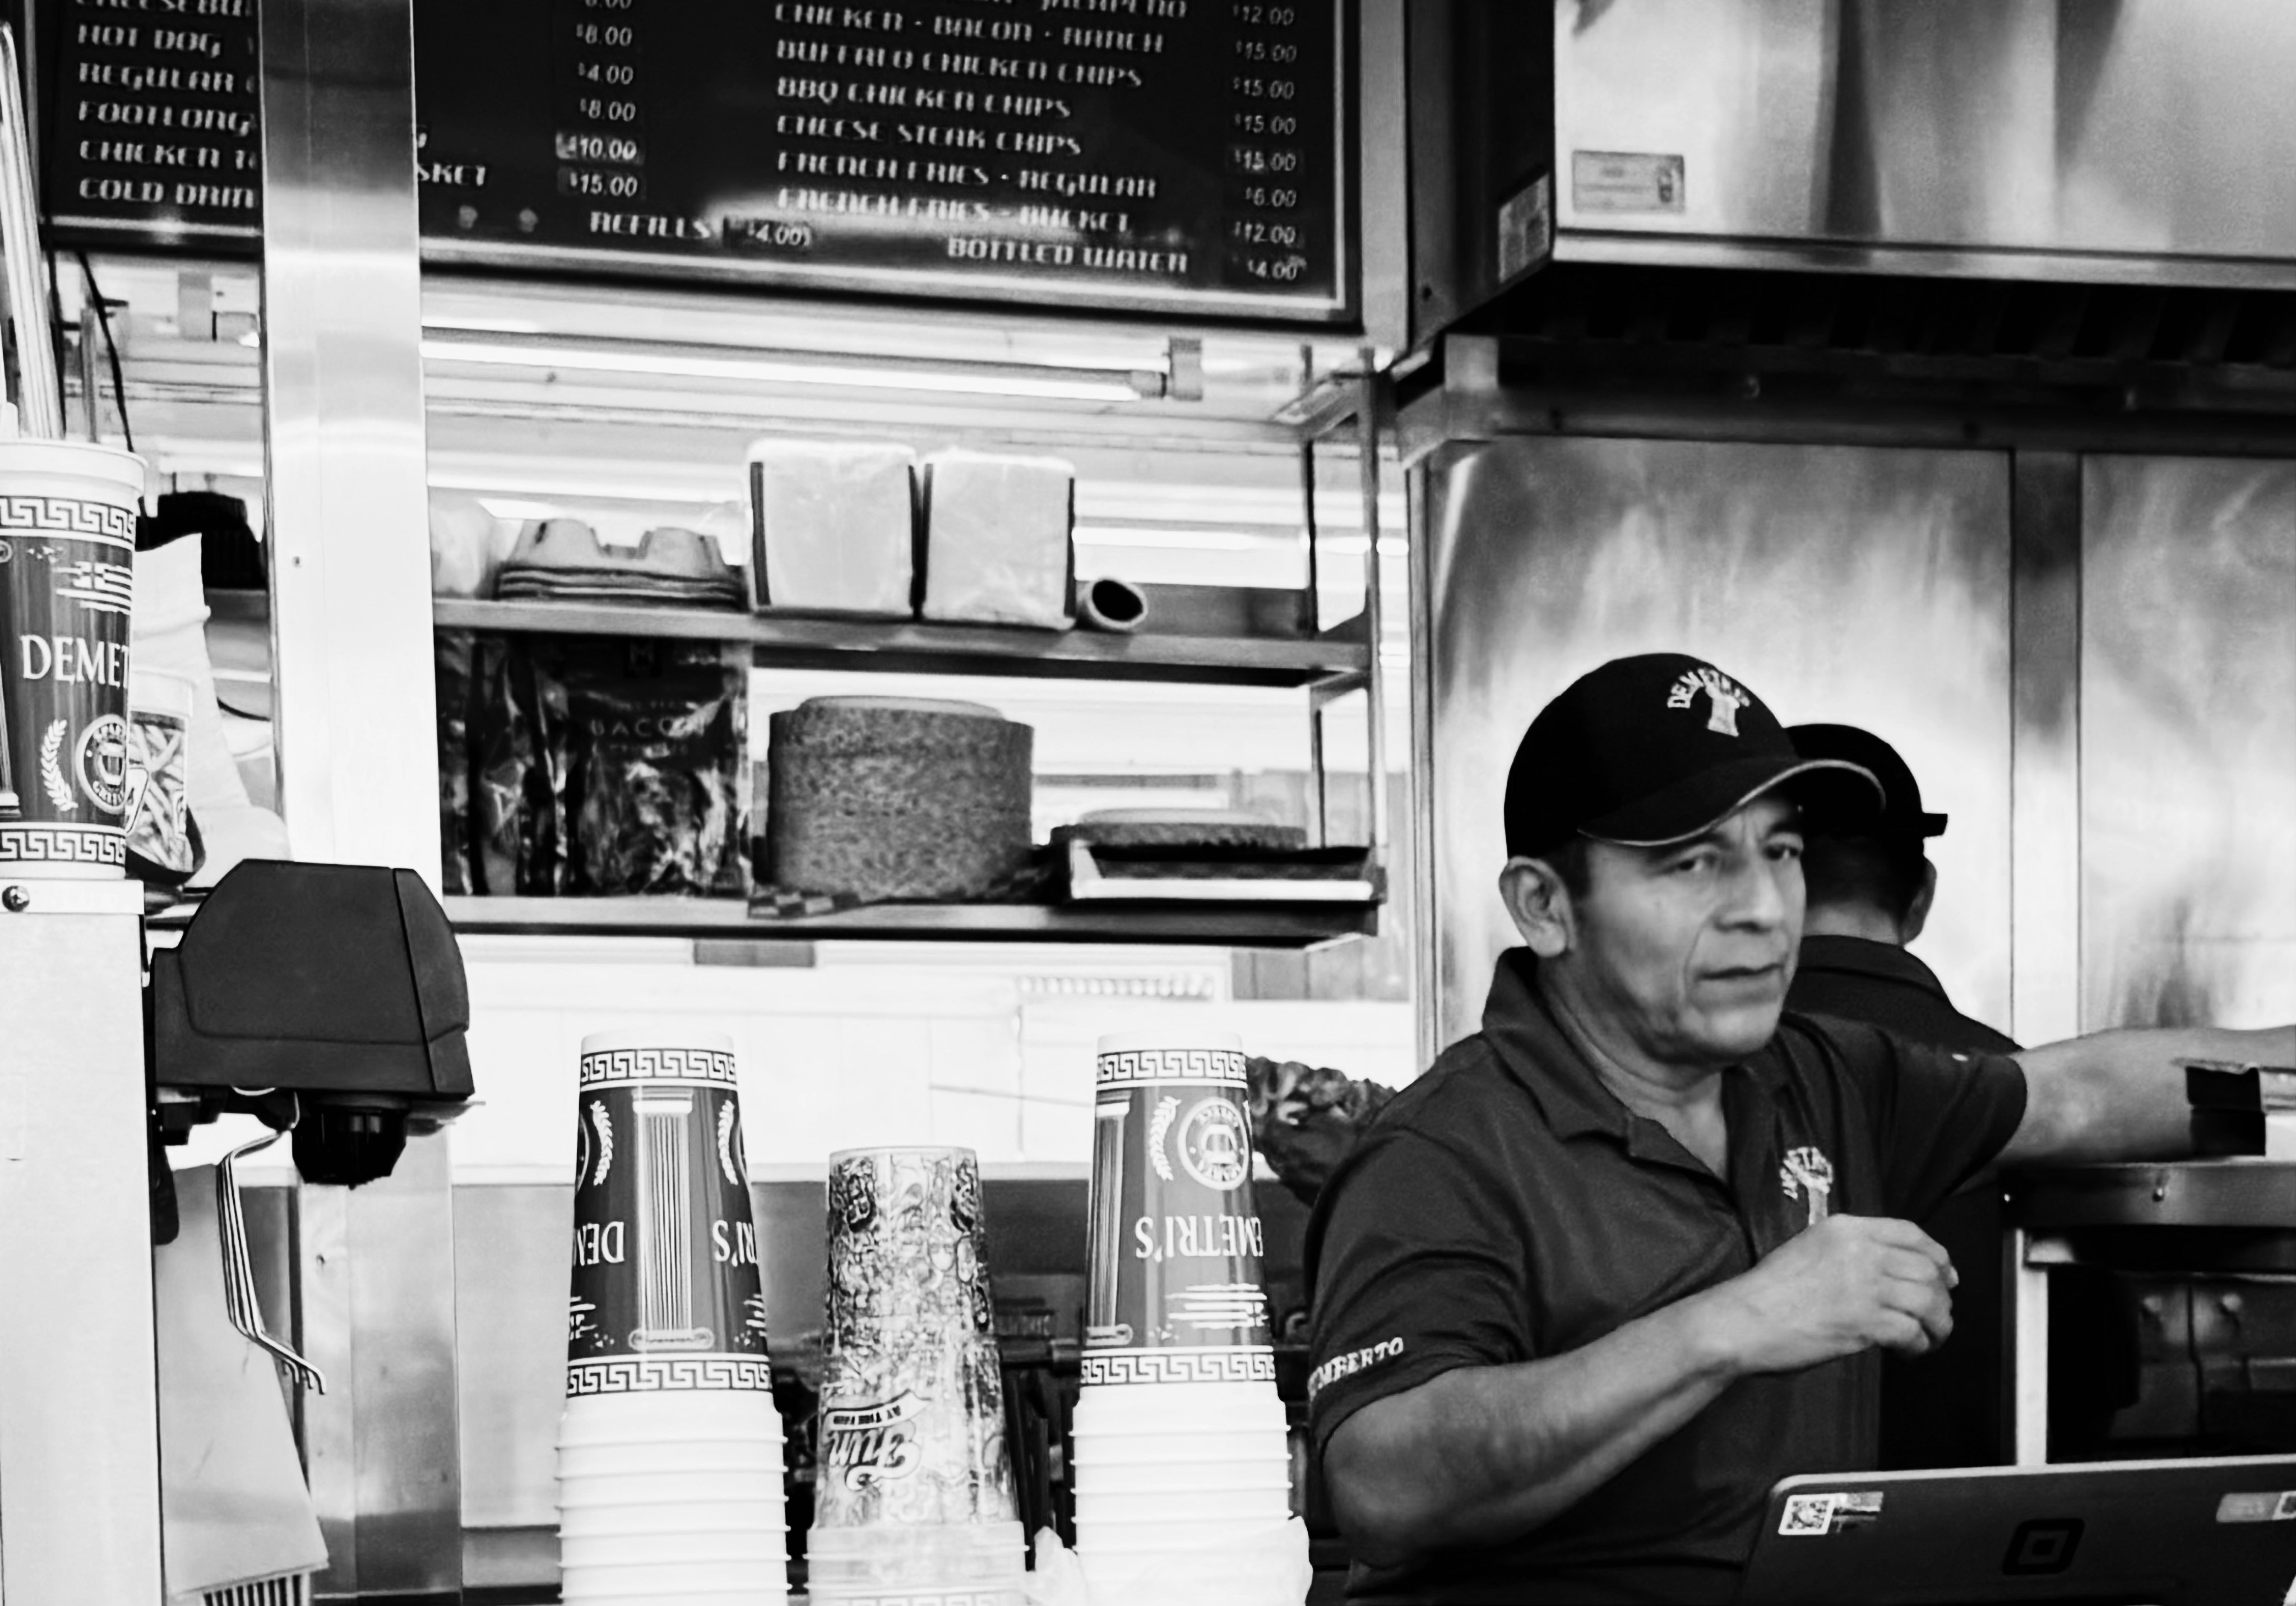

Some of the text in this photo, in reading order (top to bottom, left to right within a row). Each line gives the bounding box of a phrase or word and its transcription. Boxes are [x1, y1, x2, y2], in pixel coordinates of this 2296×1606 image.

[776, 4, 1163, 53] CHICKEN BACON RANCH
[1234, 6, 1294, 25] $12.00
[78, 25, 220, 57] HOT DOG
[1237, 41, 1297, 62] $15.00
[579, 63, 633, 85] $4.00
[777, 39, 1142, 86] BUFFALO CHICKEN CHIPS
[79, 63, 234, 92] REGULAR
[1234, 77, 1295, 99] $15.00
[580, 99, 636, 121] $8.00
[777, 77, 1071, 117] BBQ CHICKEN CHIPS
[777, 115, 1081, 155] CHEESE STEAK CHIPS
[1235, 114, 1296, 135] $15.00
[80, 141, 220, 168] CHICKEN
[570, 172, 638, 197] $15.00
[778, 151, 1156, 197] FRENCH FRIES REGULAR
[80, 178, 164, 203] COLD
[1246, 187, 1297, 207] $6.00
[591, 211, 710, 239] REFILLS
[1235, 222, 1295, 244] $12.00
[948, 238, 1187, 273] BOTTLED WATER
